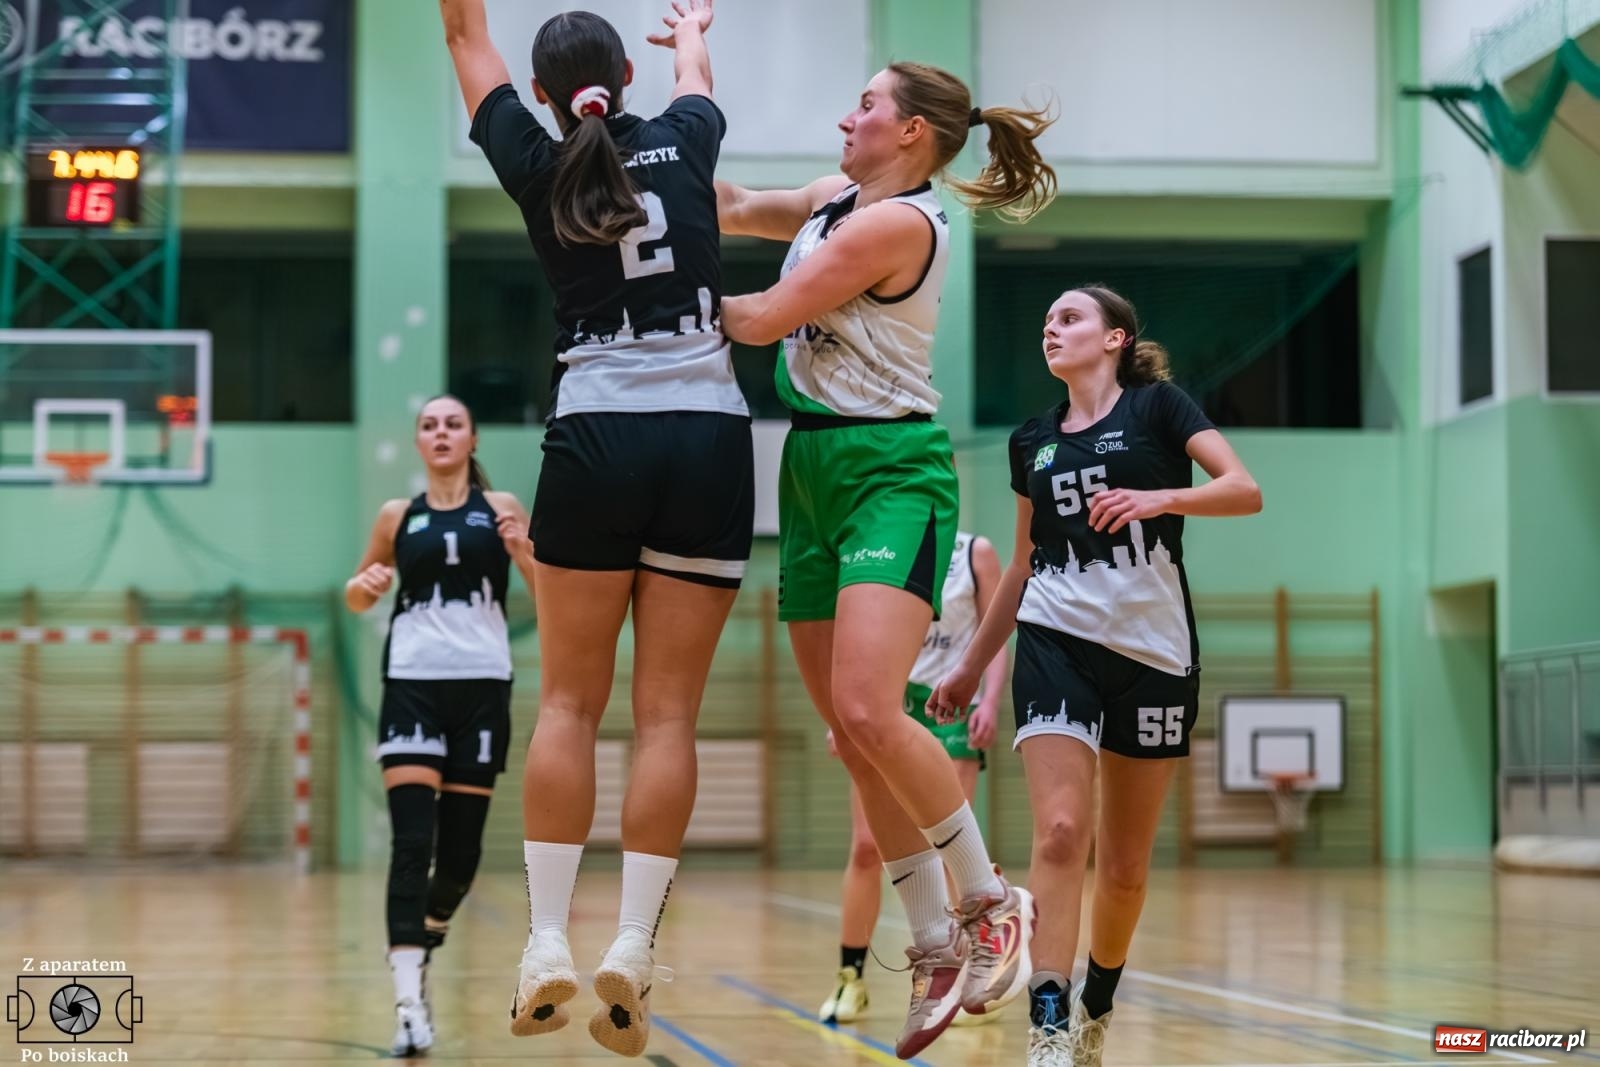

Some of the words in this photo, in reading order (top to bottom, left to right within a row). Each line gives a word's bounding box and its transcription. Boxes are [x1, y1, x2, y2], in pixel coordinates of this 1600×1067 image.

[65, 181, 117, 224] 16
[619, 190, 676, 281] 2
[1051, 464, 1110, 518] 55
[442, 530, 461, 566] 1
[476, 729, 493, 764] 1
[1137, 705, 1185, 748] 55
